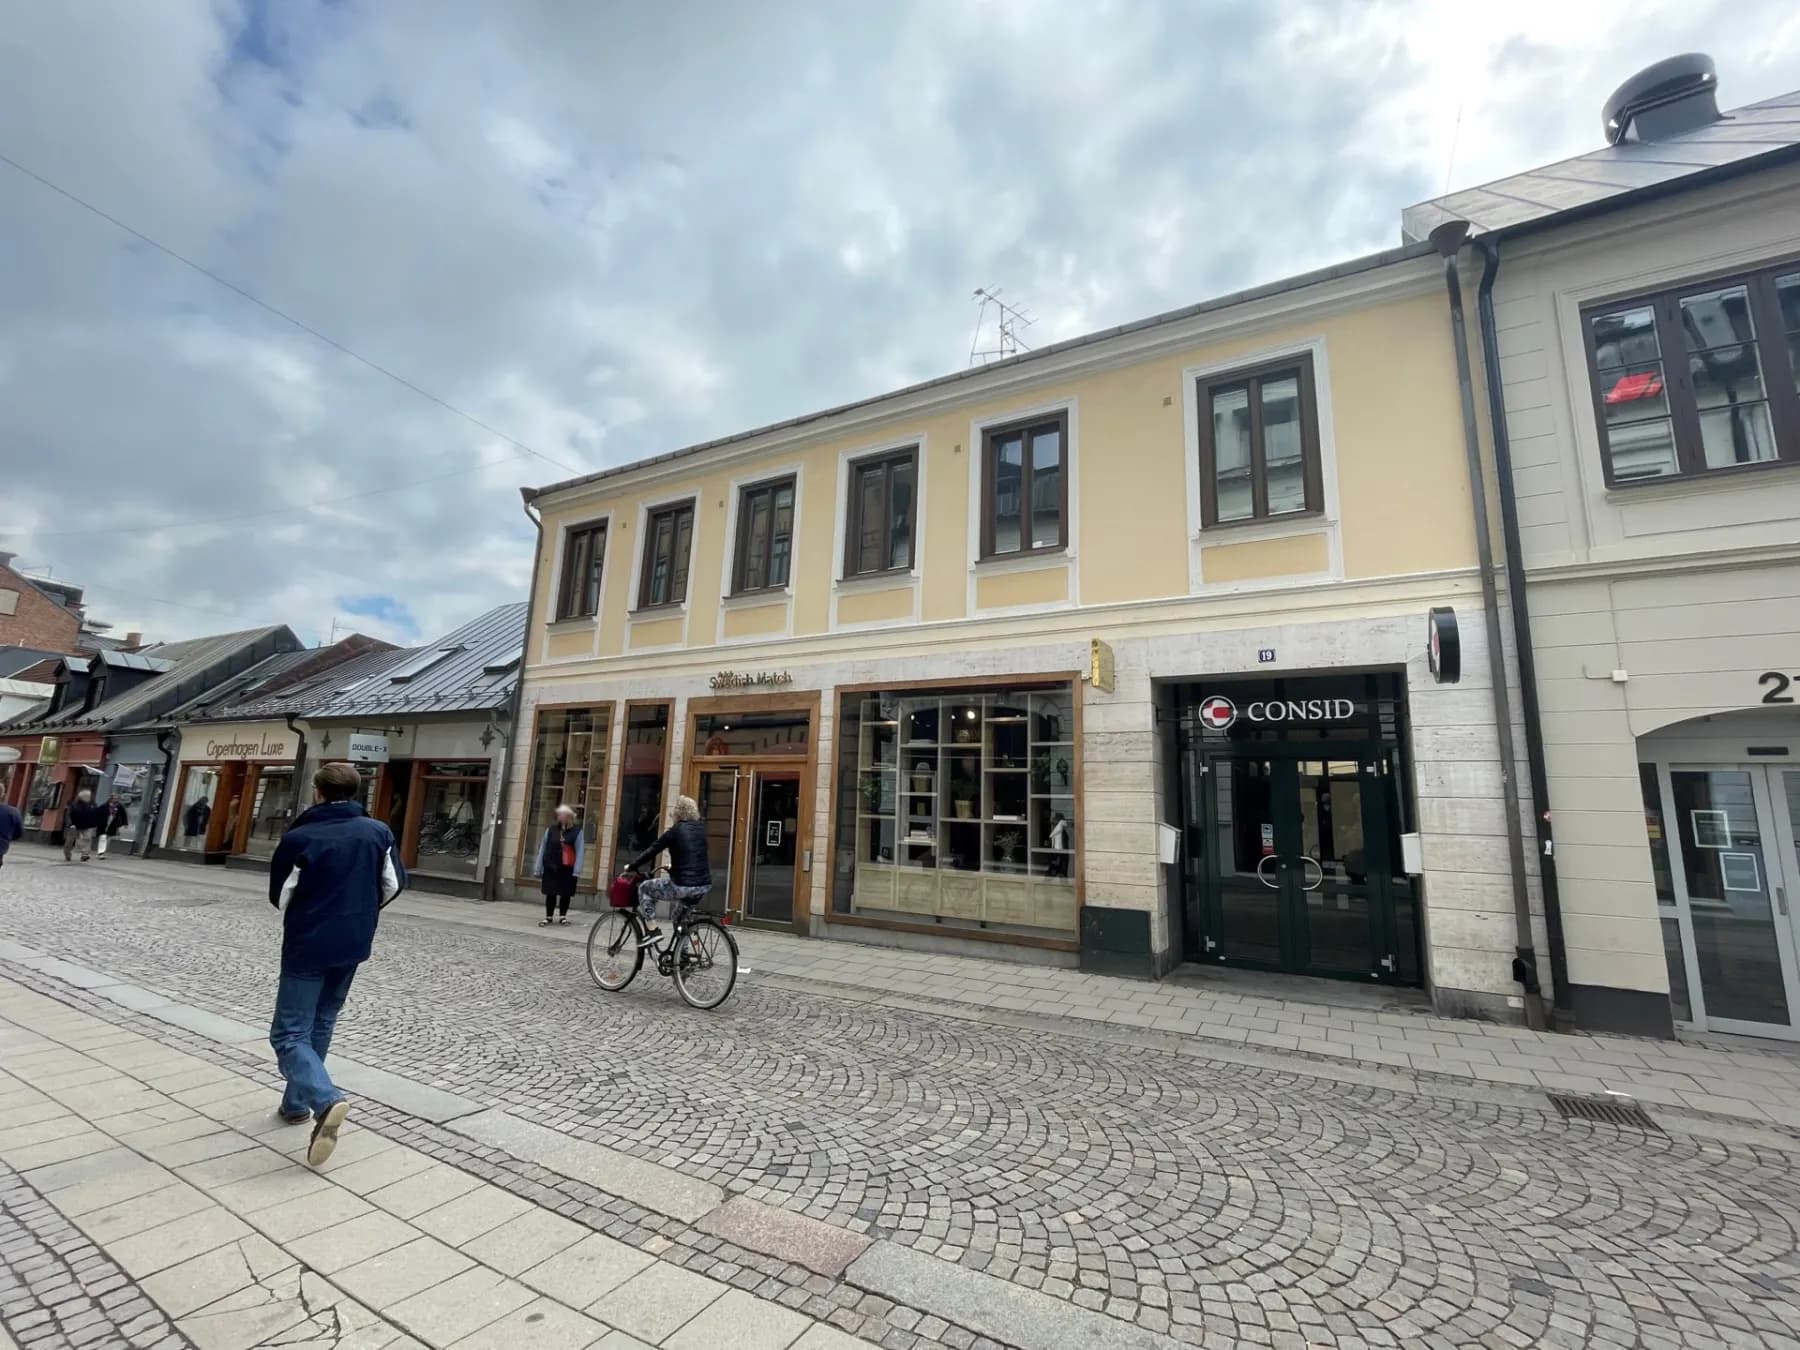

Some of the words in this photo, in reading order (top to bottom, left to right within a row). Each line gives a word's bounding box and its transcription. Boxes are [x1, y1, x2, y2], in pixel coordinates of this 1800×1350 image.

[1261, 650, 1273, 661] 19
[709, 673, 754, 689] Swedish
[757, 670, 792, 686] Match
[1758, 671, 1800, 704] 2
[1247, 698, 1355, 722] CONSID
[206, 732, 259, 760] Copenhagen
[261, 732, 285, 756] Luxe
